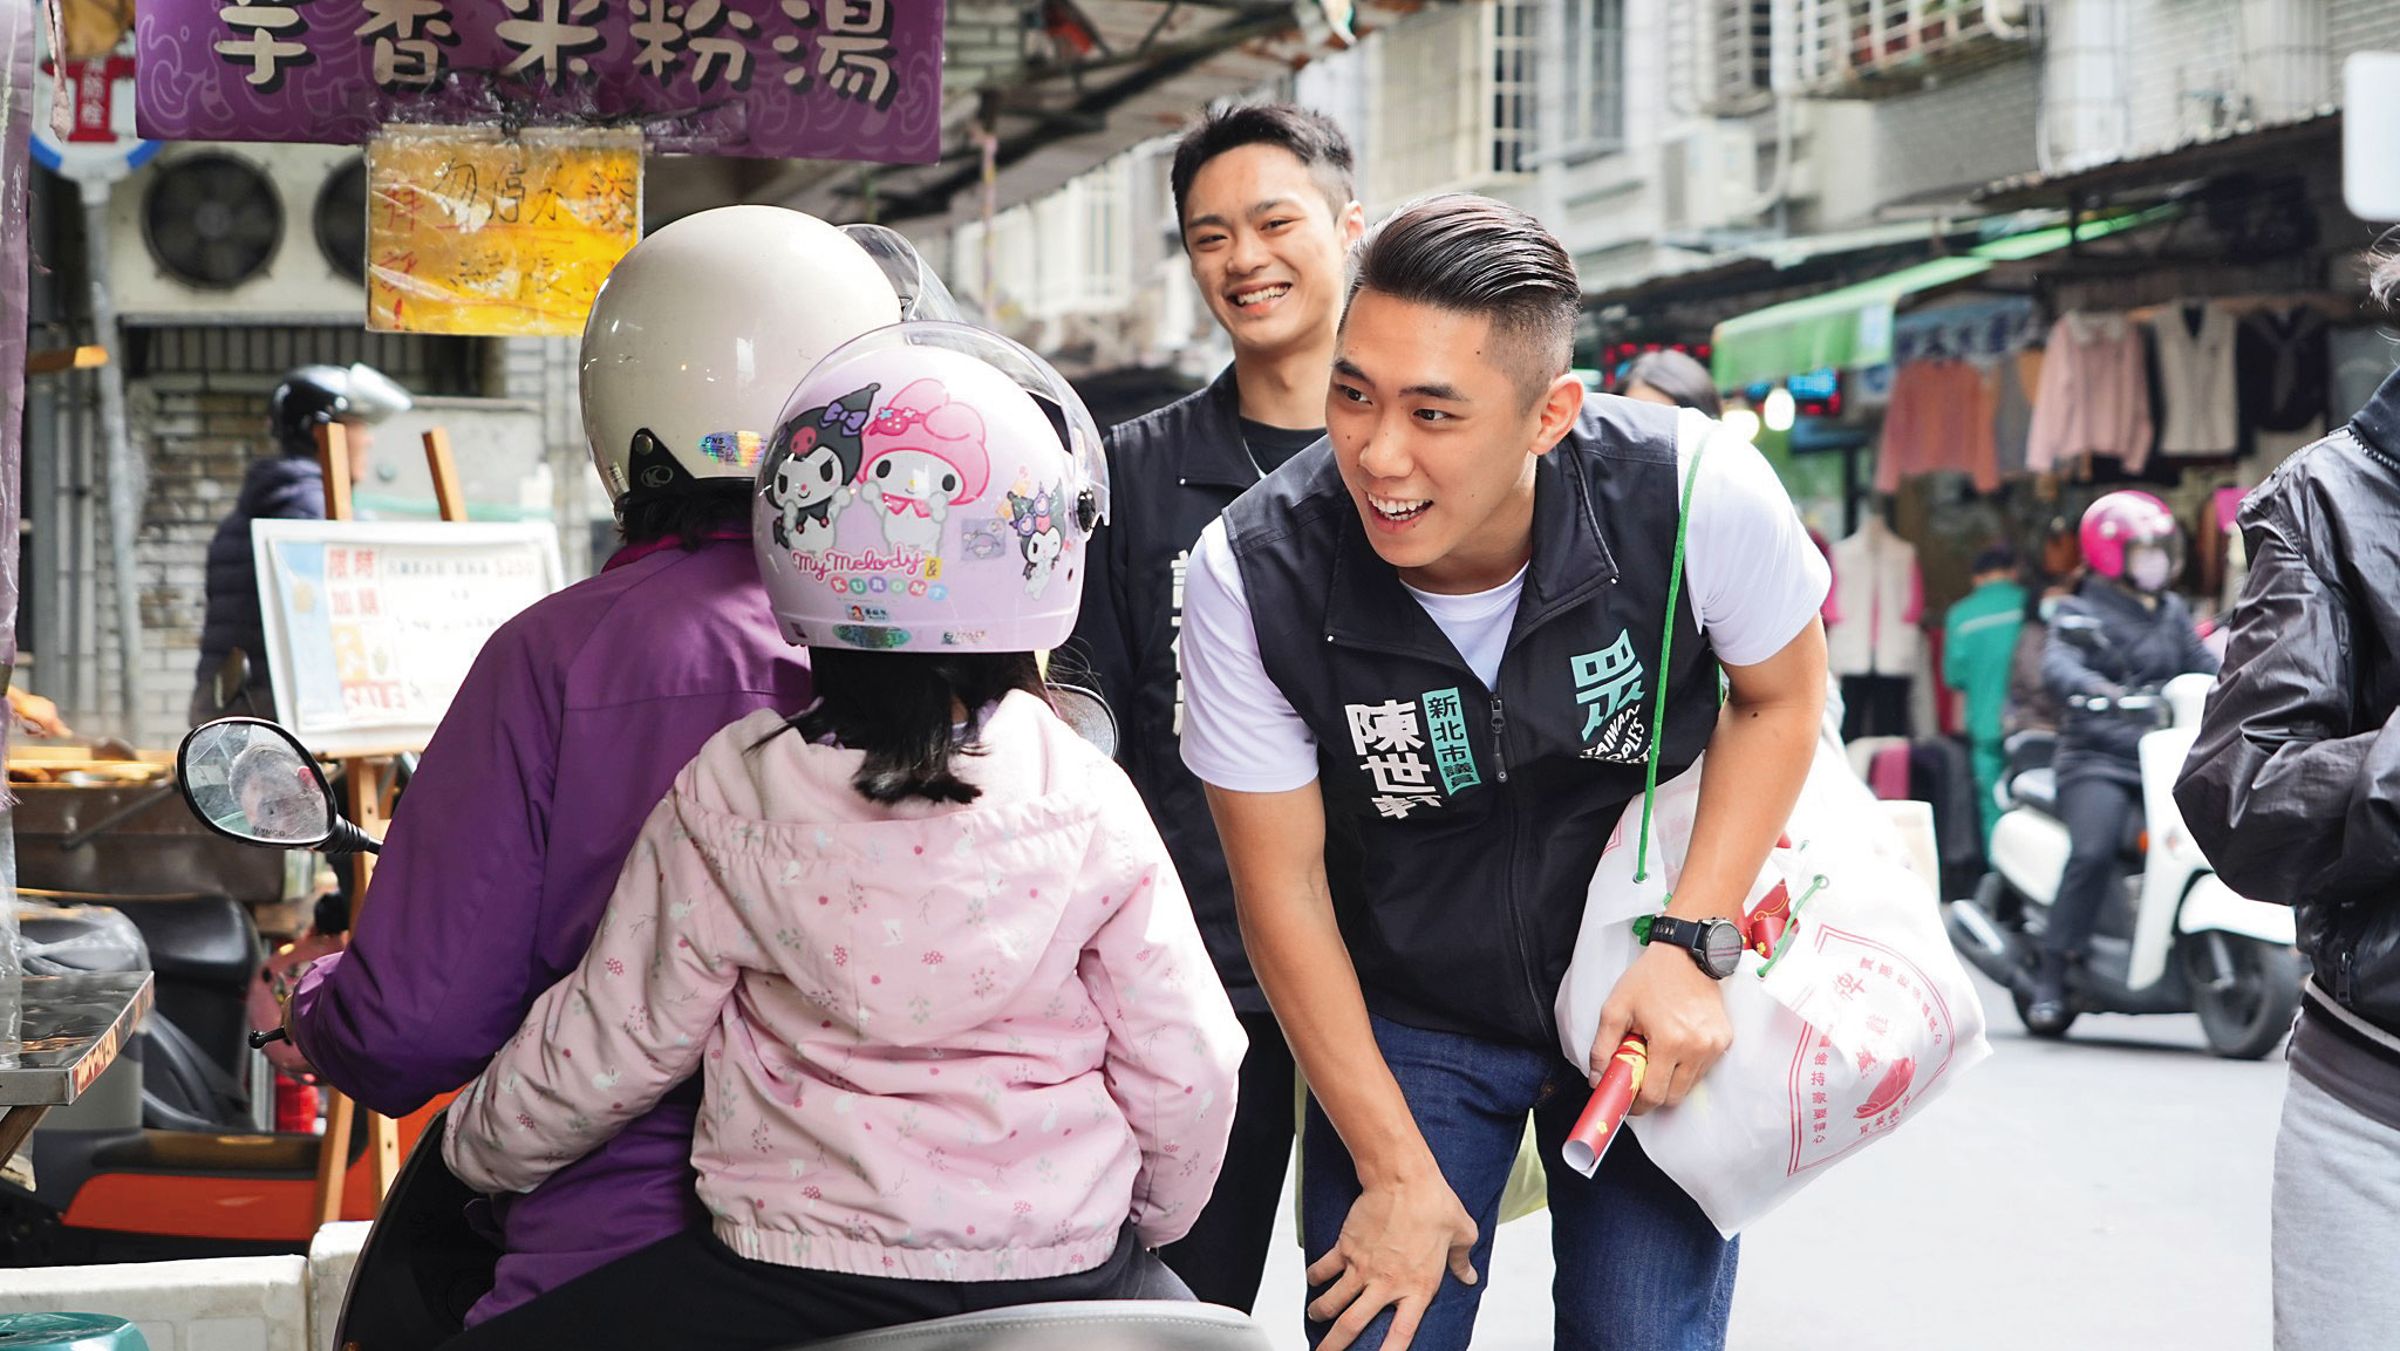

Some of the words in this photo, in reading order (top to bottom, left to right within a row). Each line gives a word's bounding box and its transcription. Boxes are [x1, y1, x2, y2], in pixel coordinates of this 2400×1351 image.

[705, 436, 724, 445] CNS
[793, 552, 831, 581] My
[826, 545, 925, 576] Melody
[832, 577, 947, 602] KUROMI
[1428, 694, 1476, 787] 新北市議員
[1583, 703, 1640, 756] TAIWAN
